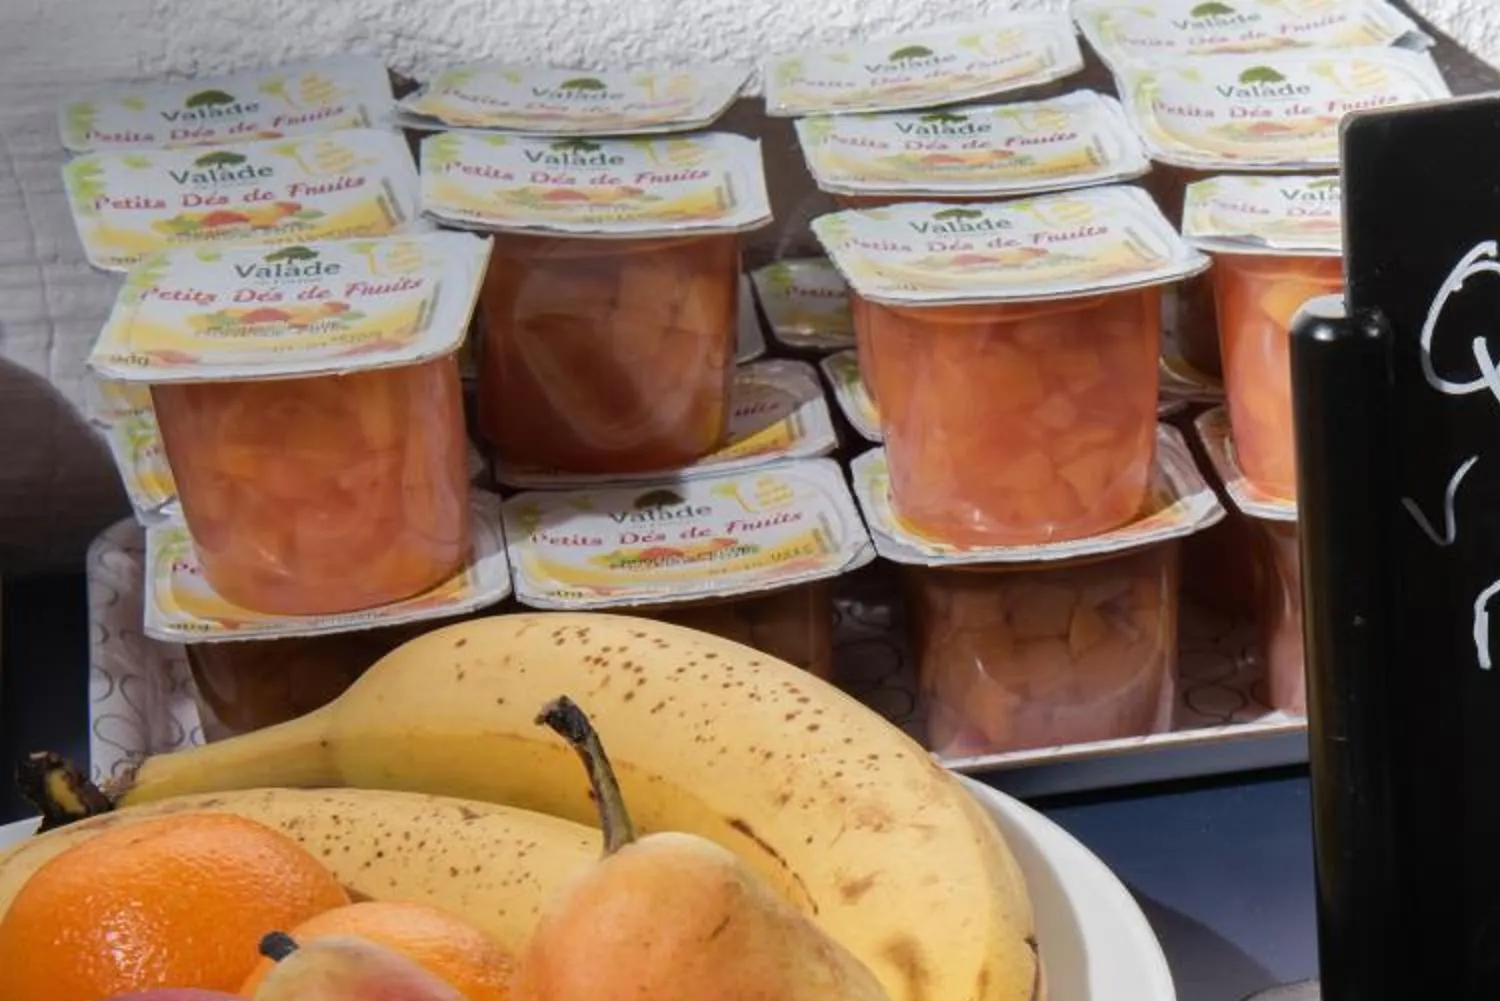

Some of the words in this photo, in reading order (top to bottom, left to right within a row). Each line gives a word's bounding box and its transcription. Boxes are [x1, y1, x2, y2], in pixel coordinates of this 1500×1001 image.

[1172, 12, 1263, 31] Valade
[864, 54, 957, 73] Valade
[1215, 84, 1311, 99] Valade
[160, 102, 261, 123] Valade
[895, 121, 993, 136] Valade
[523, 149, 625, 166] Valade
[169, 164, 274, 185] Valade
[94, 194, 167, 211] Petits
[182, 188, 230, 208] Dés
[243, 187, 274, 203] de
[287, 175, 366, 198] Fruits
[908, 216, 1015, 236] Valade
[233, 261, 342, 279] Valade
[140, 287, 217, 305] Petits
[233, 285, 283, 302] Dés
[297, 286, 330, 300] de
[344, 276, 425, 298] Fruits
[608, 506, 713, 524] Valade
[530, 531, 603, 547] Petits
[619, 528, 666, 545] Dés
[680, 526, 712, 541] de
[727, 511, 803, 534] Fruits
